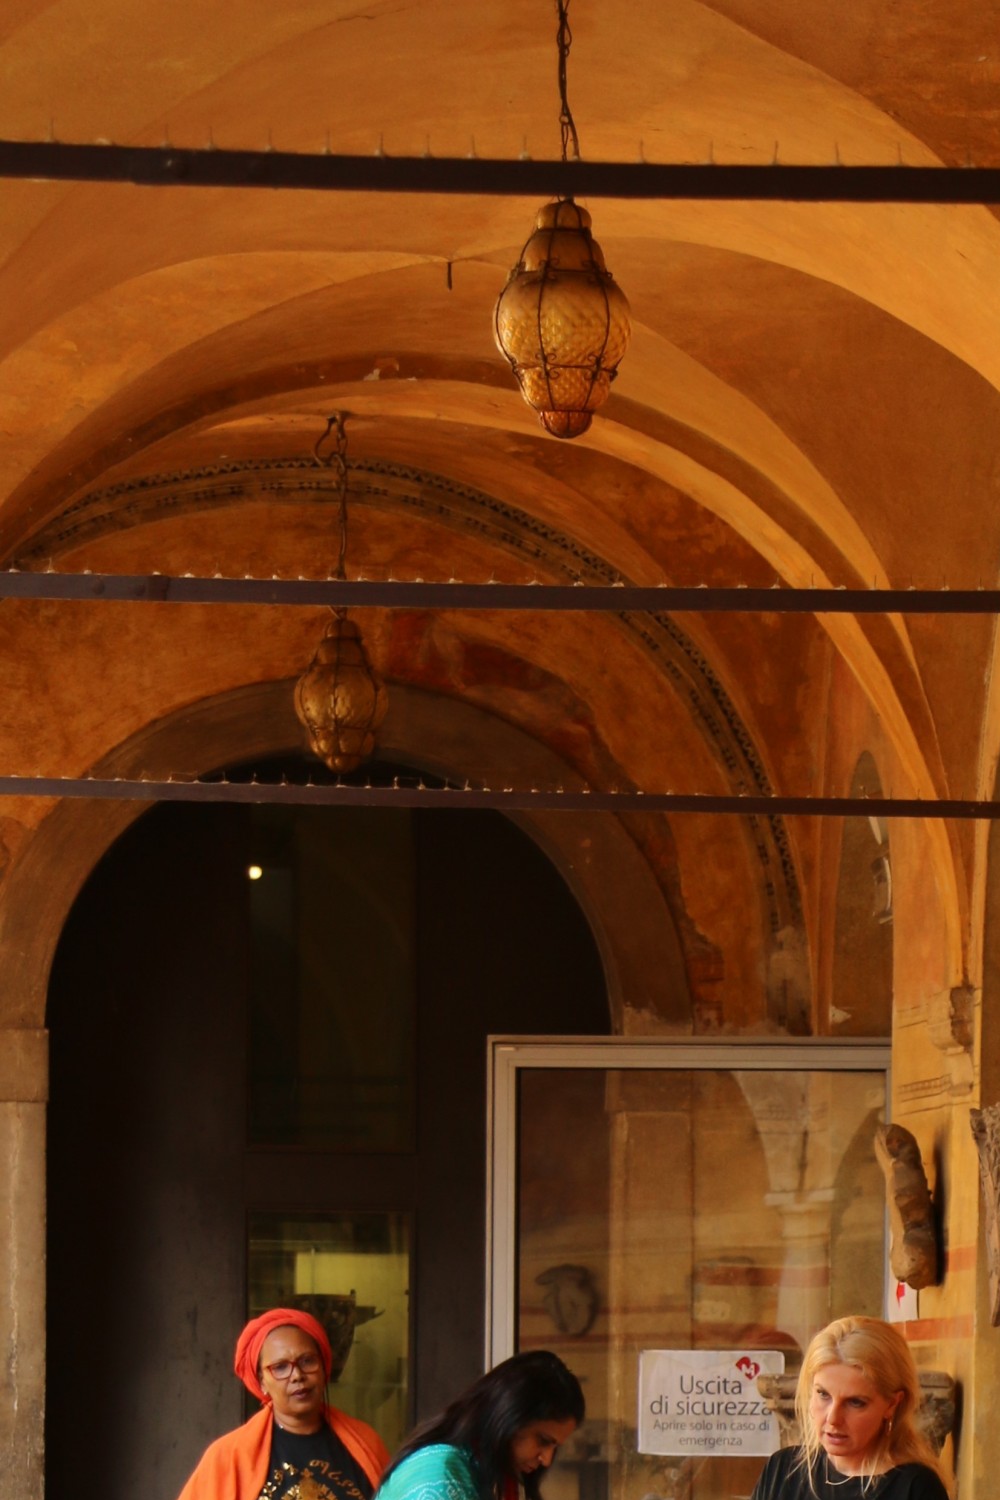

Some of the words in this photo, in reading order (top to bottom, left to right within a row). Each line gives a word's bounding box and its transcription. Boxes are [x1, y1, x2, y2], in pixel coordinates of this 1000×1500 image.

[680, 1375, 742, 1395] Uscita
[650, 1394, 668, 1415] di
[676, 1396, 772, 1416] sicurezza
[653, 1419, 687, 1432] Aprire
[690, 1419, 713, 1431] solo
[717, 1420, 727, 1431] in
[731, 1421, 756, 1431] caso
[758, 1419, 770, 1431] di
[679, 1435, 743, 1449] emergenza
